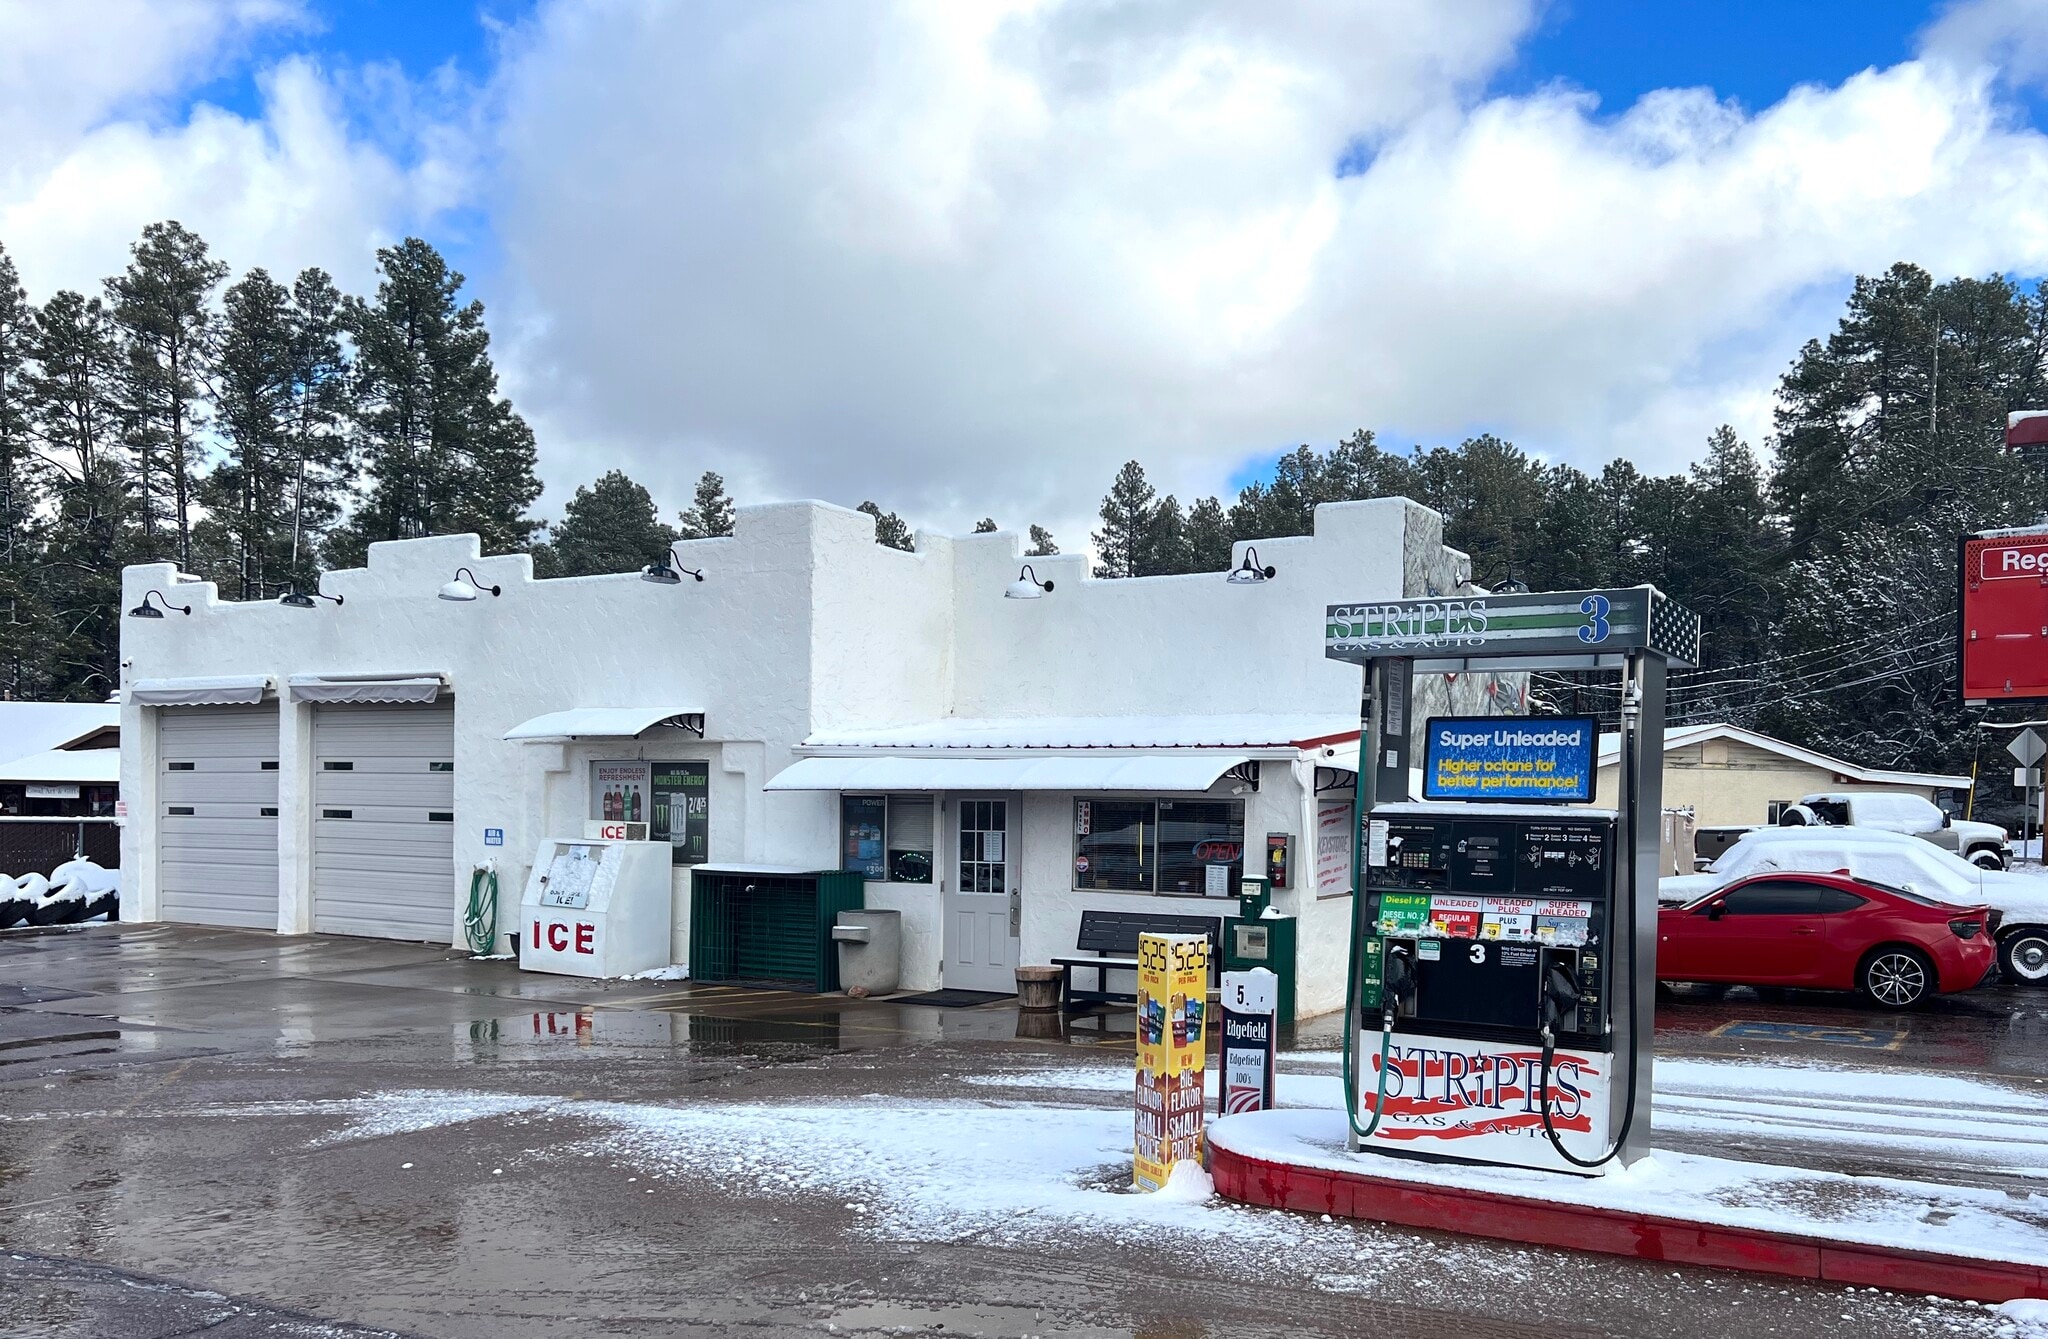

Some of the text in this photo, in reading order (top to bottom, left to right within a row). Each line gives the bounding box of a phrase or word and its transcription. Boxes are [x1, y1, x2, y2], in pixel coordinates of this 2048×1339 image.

[1577, 594, 1611, 643] 3
[1333, 640, 1382, 651] GAS
[1389, 640, 1407, 648] &
[1439, 730, 1581, 750] Super Unleaded
[1438, 758, 1557, 774] Higher octane for
[654, 775, 706, 786] MONSTER ENERGY
[1437, 774, 1579, 789] better performance!
[601, 826, 625, 840] ICE
[1197, 843, 1241, 861] OPEN
[1386, 895, 1426, 905] Diesel #2
[1434, 899, 1479, 908] UNLEADED
[1487, 898, 1533, 907] UNLEADED
[1549, 901, 1579, 909] SUPER
[1383, 910, 1425, 920] DIESEL NO. 2
[1438, 913, 1470, 922] REGULAR
[1498, 906, 1520, 914] PLUS
[1539, 908, 1587, 917] UNLEADED
[1499, 917, 1518, 925] PLUS
[533, 918, 595, 954] ICE
[1469, 944, 1486, 964] 3
[1150, 975, 1159, 984] PACK
[1187, 975, 1198, 983] PACK
[1226, 1019, 1267, 1040] Edgefield
[1144, 1052, 1154, 1067] NEW
[1181, 1053, 1193, 1067] NEW
[1229, 1052, 1261, 1067] Edgefield
[1143, 1067, 1155, 1089] BIG
[1180, 1068, 1193, 1089] BIG
[1235, 1072, 1252, 1085] 100's
[1137, 1084, 1163, 1112] FLAVOR
[1171, 1086, 1201, 1112] FLAVOR
[1136, 1108, 1163, 1141] SMALL
[1169, 1110, 1201, 1141] SMALL
[1393, 1112, 1562, 1141] GAS & AUTO
[1137, 1133, 1161, 1165] PRICE
[1171, 1134, 1198, 1164] PRICE
